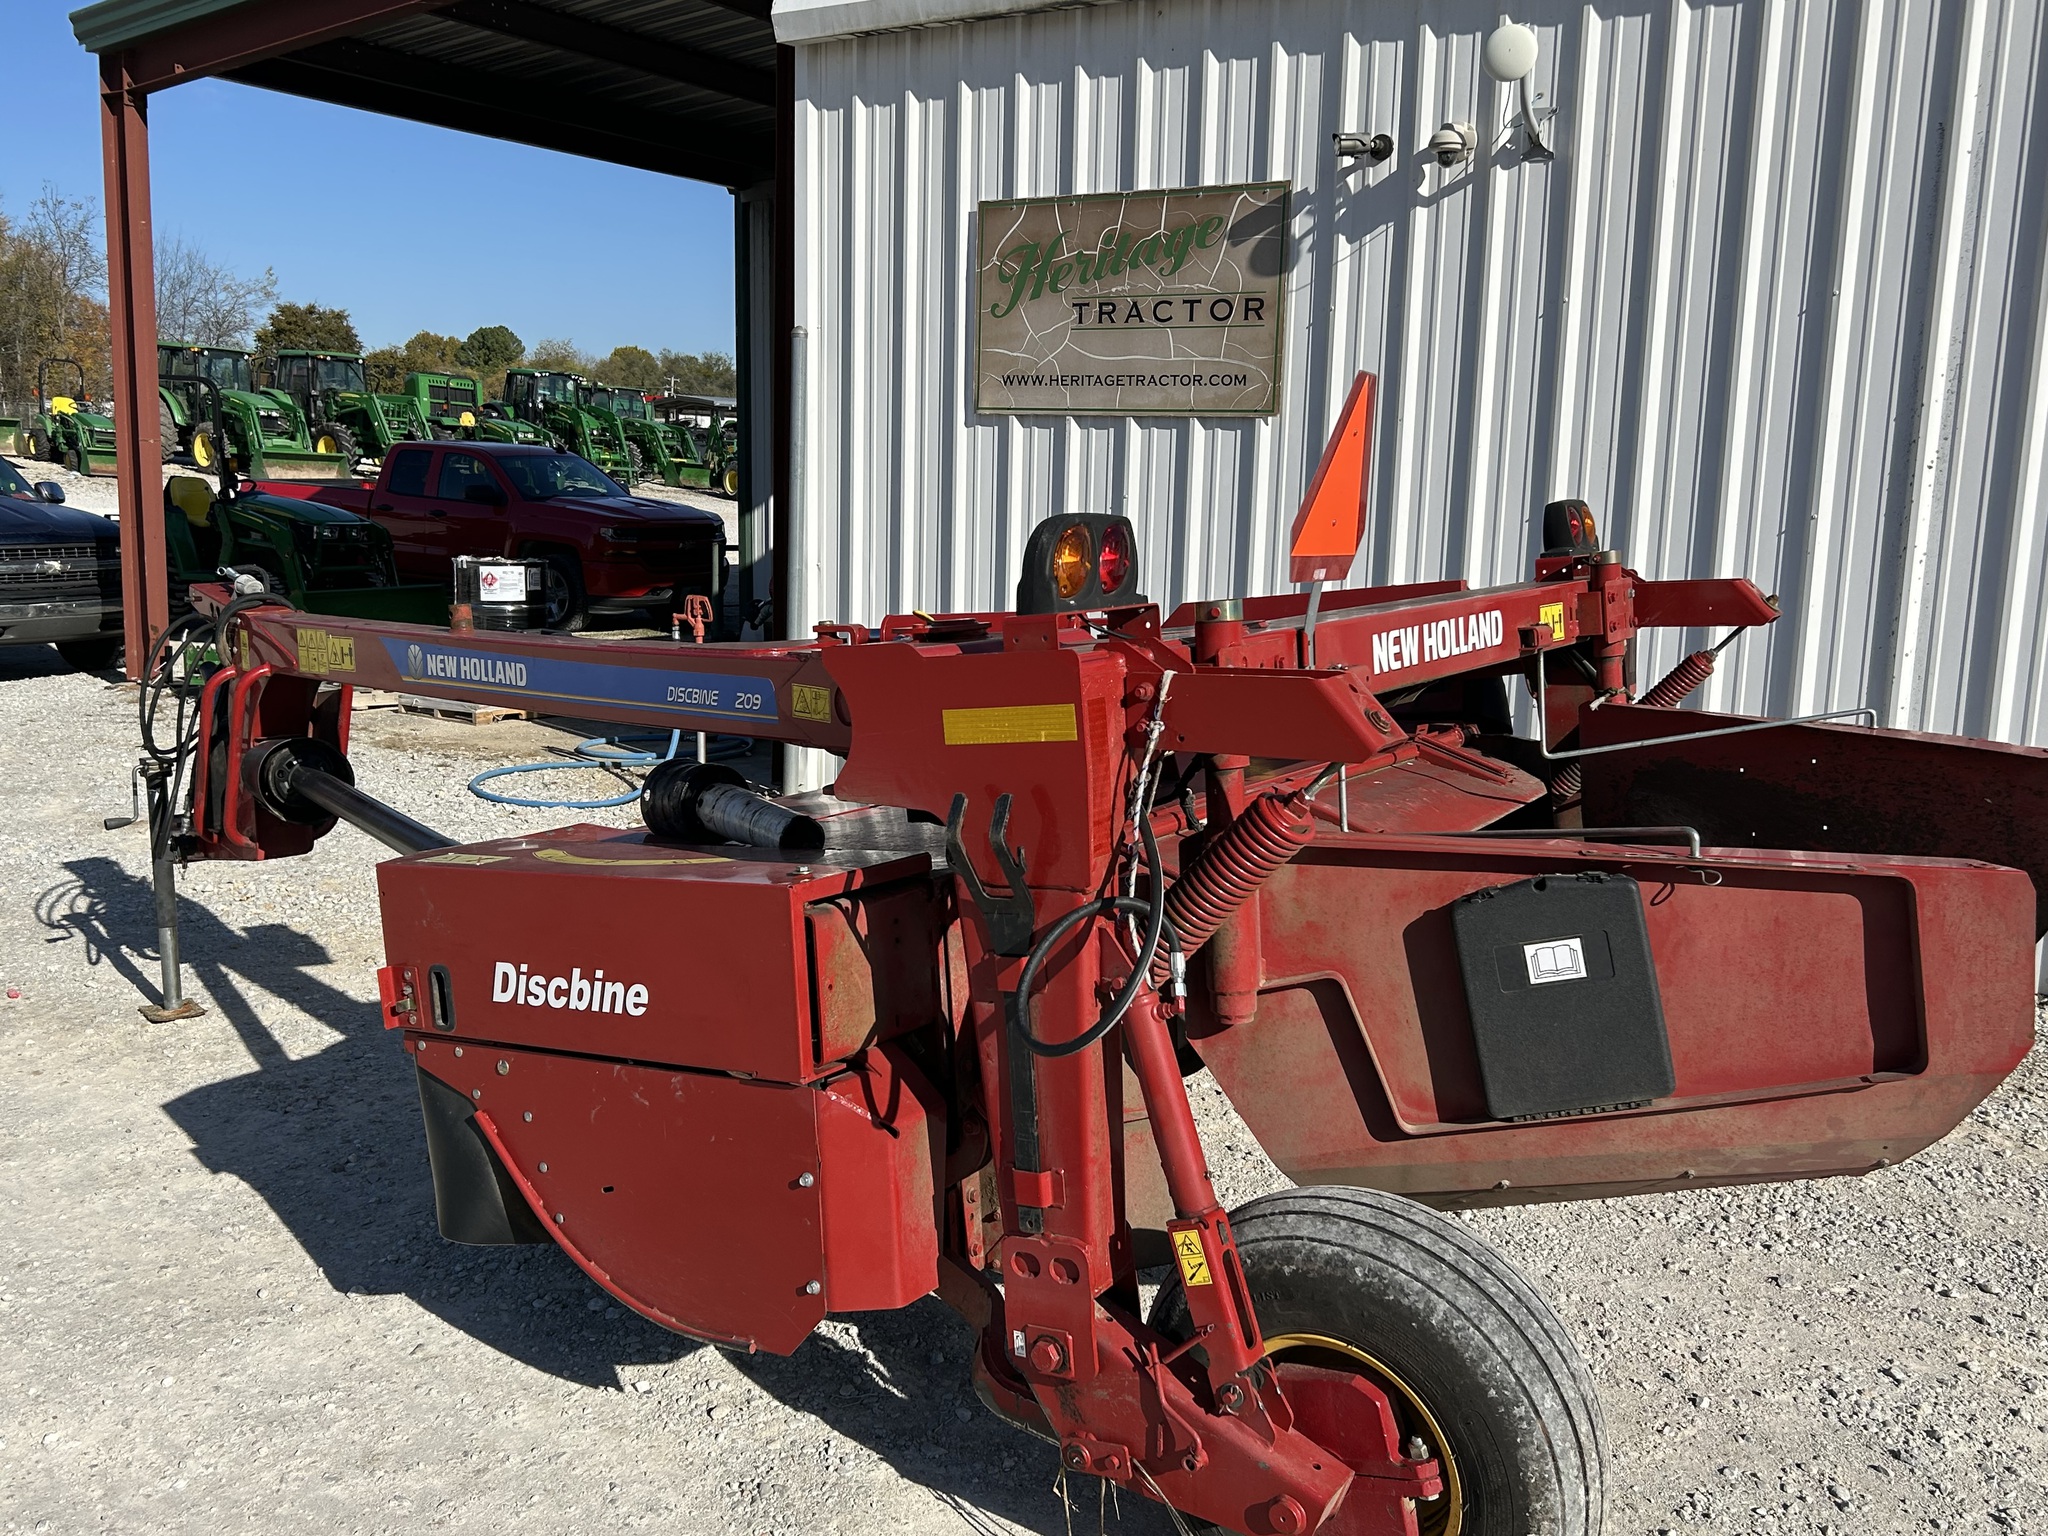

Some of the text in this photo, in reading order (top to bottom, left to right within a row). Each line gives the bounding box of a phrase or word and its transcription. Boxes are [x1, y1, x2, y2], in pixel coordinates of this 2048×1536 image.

[990, 215, 1225, 319] Heritage
[1072, 297, 1265, 326] TRACTOR
[1001, 373, 1247, 388] WWW.HERITAGETRACTOR.COM
[1372, 609, 1504, 676] NEW HOLLAND
[427, 653, 527, 687] NEW HOLLAND
[667, 686, 762, 710] DISCBINE 209
[492, 961, 649, 1017] Discbine
